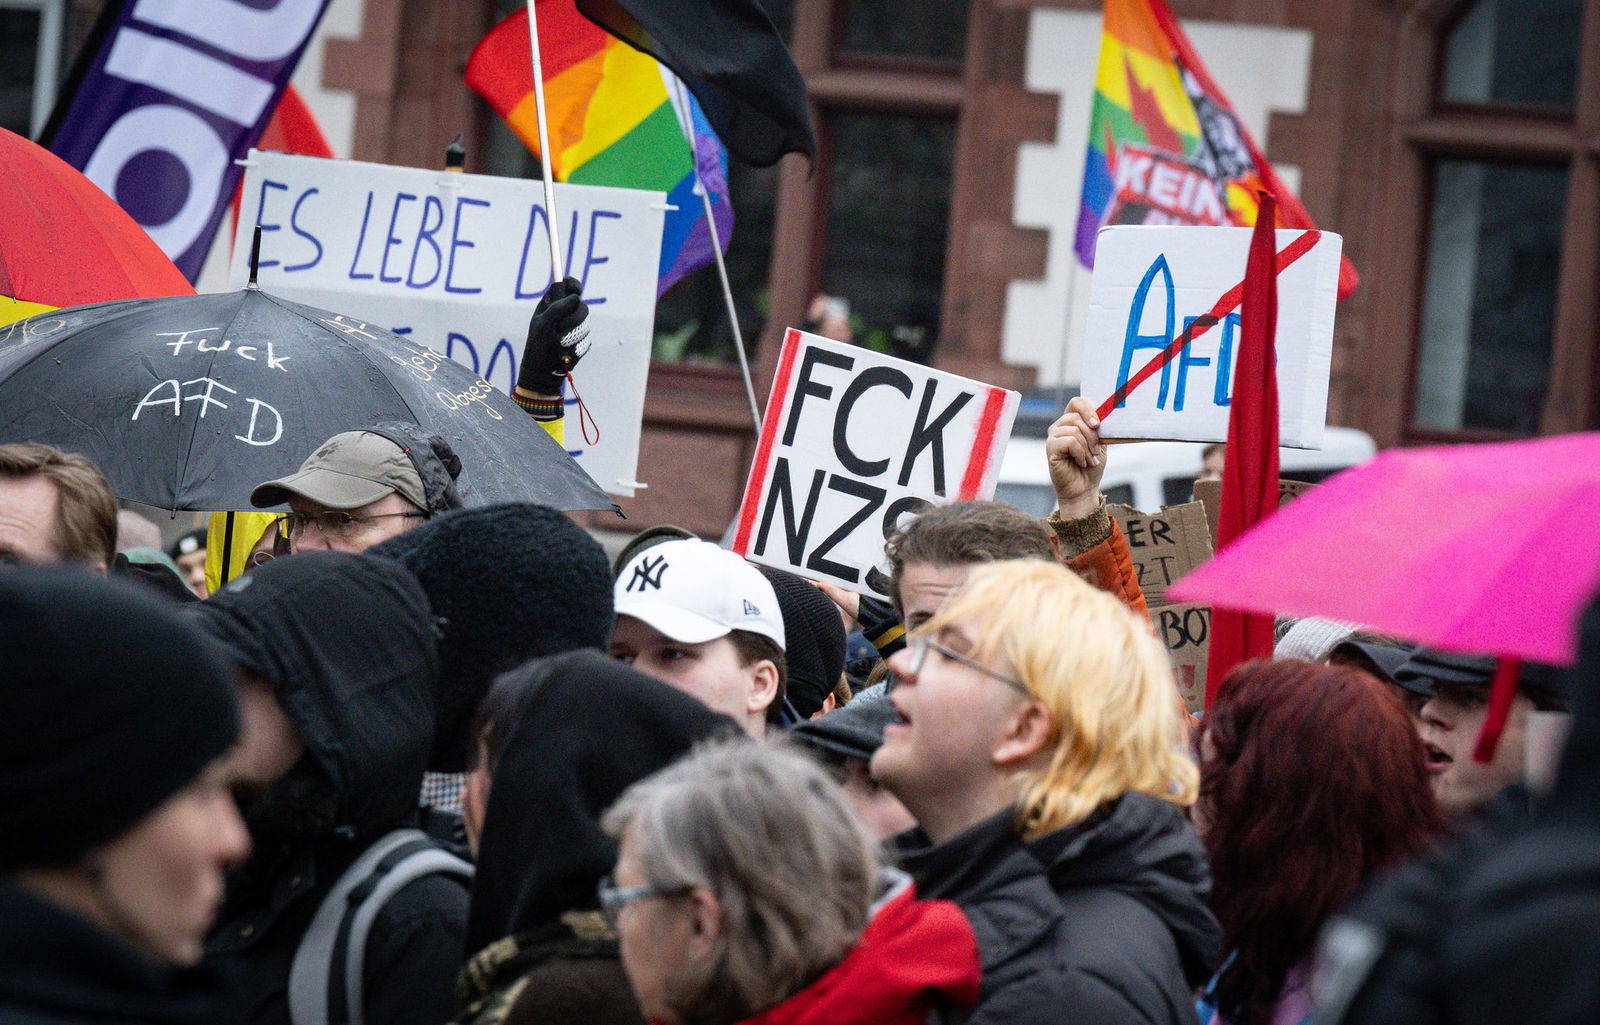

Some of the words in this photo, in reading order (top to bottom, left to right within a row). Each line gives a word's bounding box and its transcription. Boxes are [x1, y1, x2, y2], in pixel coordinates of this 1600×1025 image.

[248, 179, 323, 274] ES
[348, 191, 491, 295] LEBE
[514, 203, 622, 305] DIE
[781, 345, 976, 499] FCK
